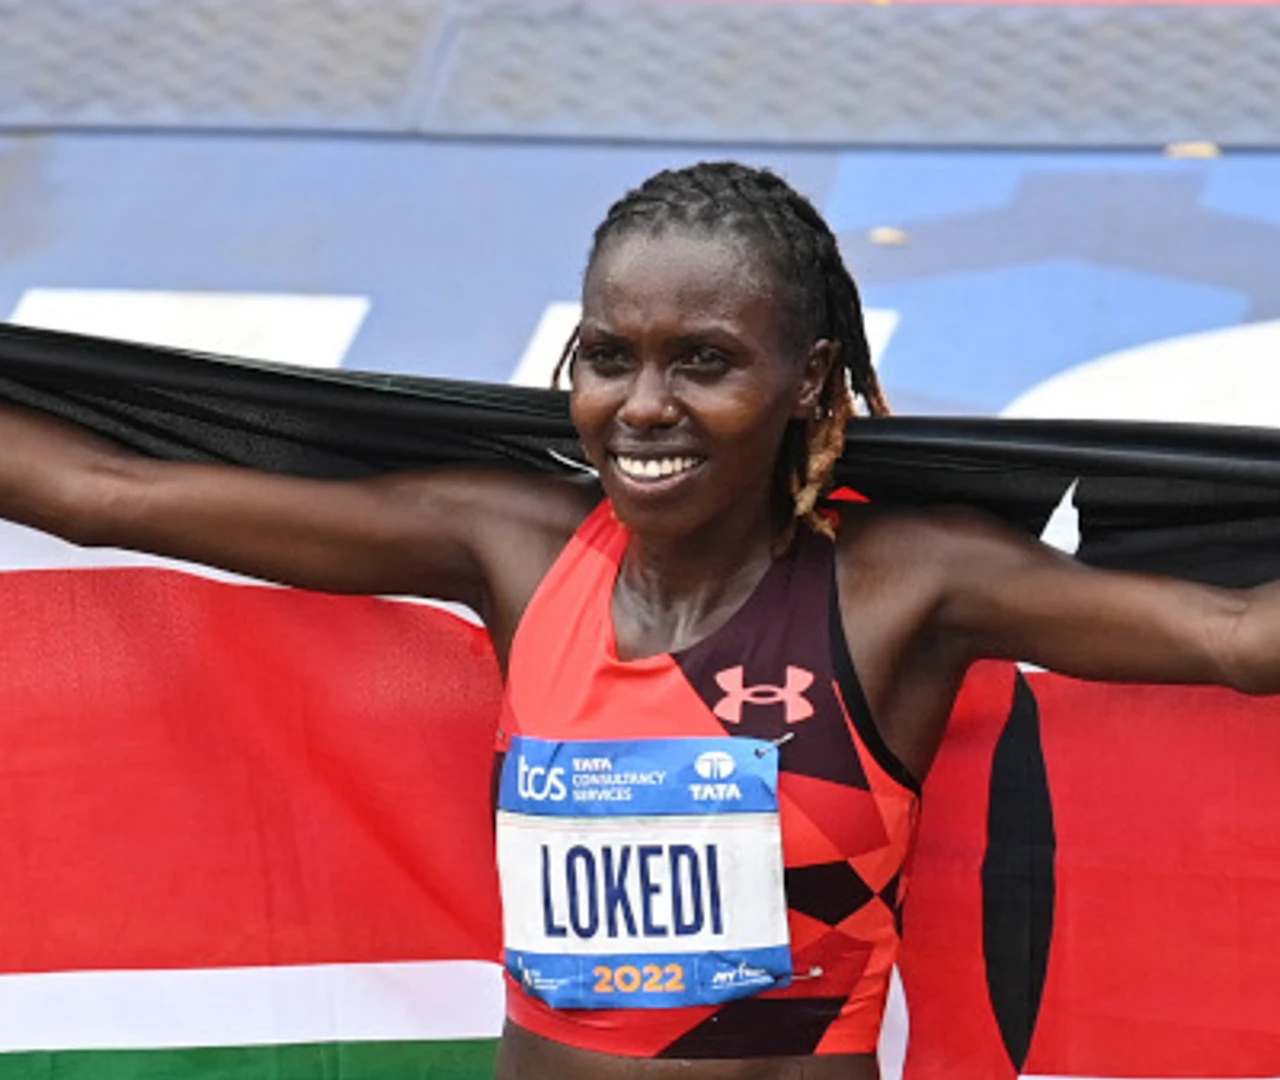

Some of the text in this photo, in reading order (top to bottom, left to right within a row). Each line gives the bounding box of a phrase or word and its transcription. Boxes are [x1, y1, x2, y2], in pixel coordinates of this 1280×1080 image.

[572, 758, 612, 772] TATA
[518, 755, 566, 801] tcs
[572, 772, 666, 786] CONSULTANCY
[572, 788, 632, 801] SERVICES
[689, 783, 742, 800] TATA
[541, 844, 724, 938] LOKEDI
[593, 963, 686, 993] 2022
